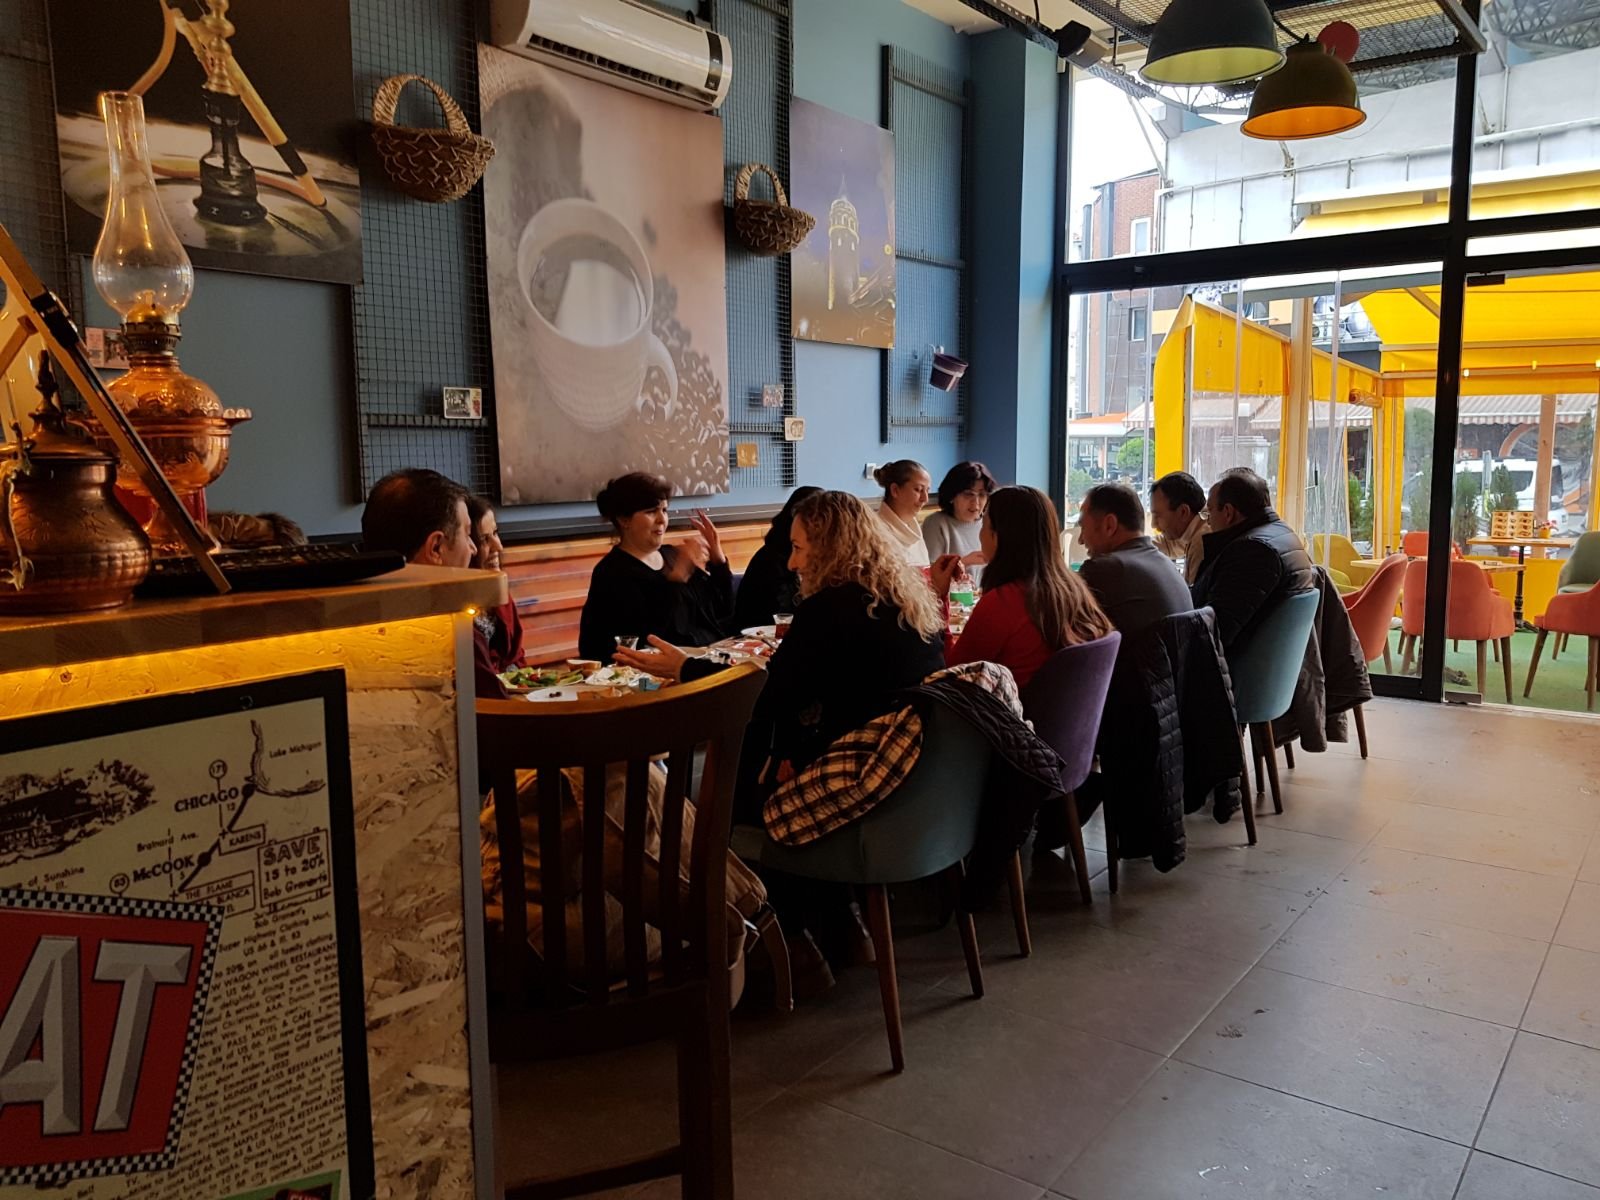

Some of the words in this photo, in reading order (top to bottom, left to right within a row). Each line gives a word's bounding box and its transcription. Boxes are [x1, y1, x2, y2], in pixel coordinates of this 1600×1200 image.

[269, 749, 287, 759] Lake
[174, 786, 240, 813] CHICAGO
[263, 835, 321, 867] SAVE
[43, 866, 85, 883] Sunshine
[132, 854, 195, 883] McCOOK
[265, 868, 280, 883] 15
[284, 864, 297, 877] to
[301, 852, 326, 873] 20%
[186, 886, 200, 900] THE
[207, 880, 234, 894] FLAME
[263, 885, 282, 901] Bob
[224, 970, 258, 986] WAGON
[262, 960, 286, 973] WHEEL
[290, 942, 337, 963] RESTAURANT
[227, 1035, 246, 1048] PASS
[251, 1025, 277, 1038] MOTEL
[223, 1082, 257, 1100] MUNGER
[262, 1071, 284, 1085] MOSS
[287, 1050, 332, 1074] RESTAURANT
[233, 1132, 257, 1147] MAPLE
[261, 1120, 285, 1135] MOTEL
[297, 1094, 341, 1118] RESTAURANT
